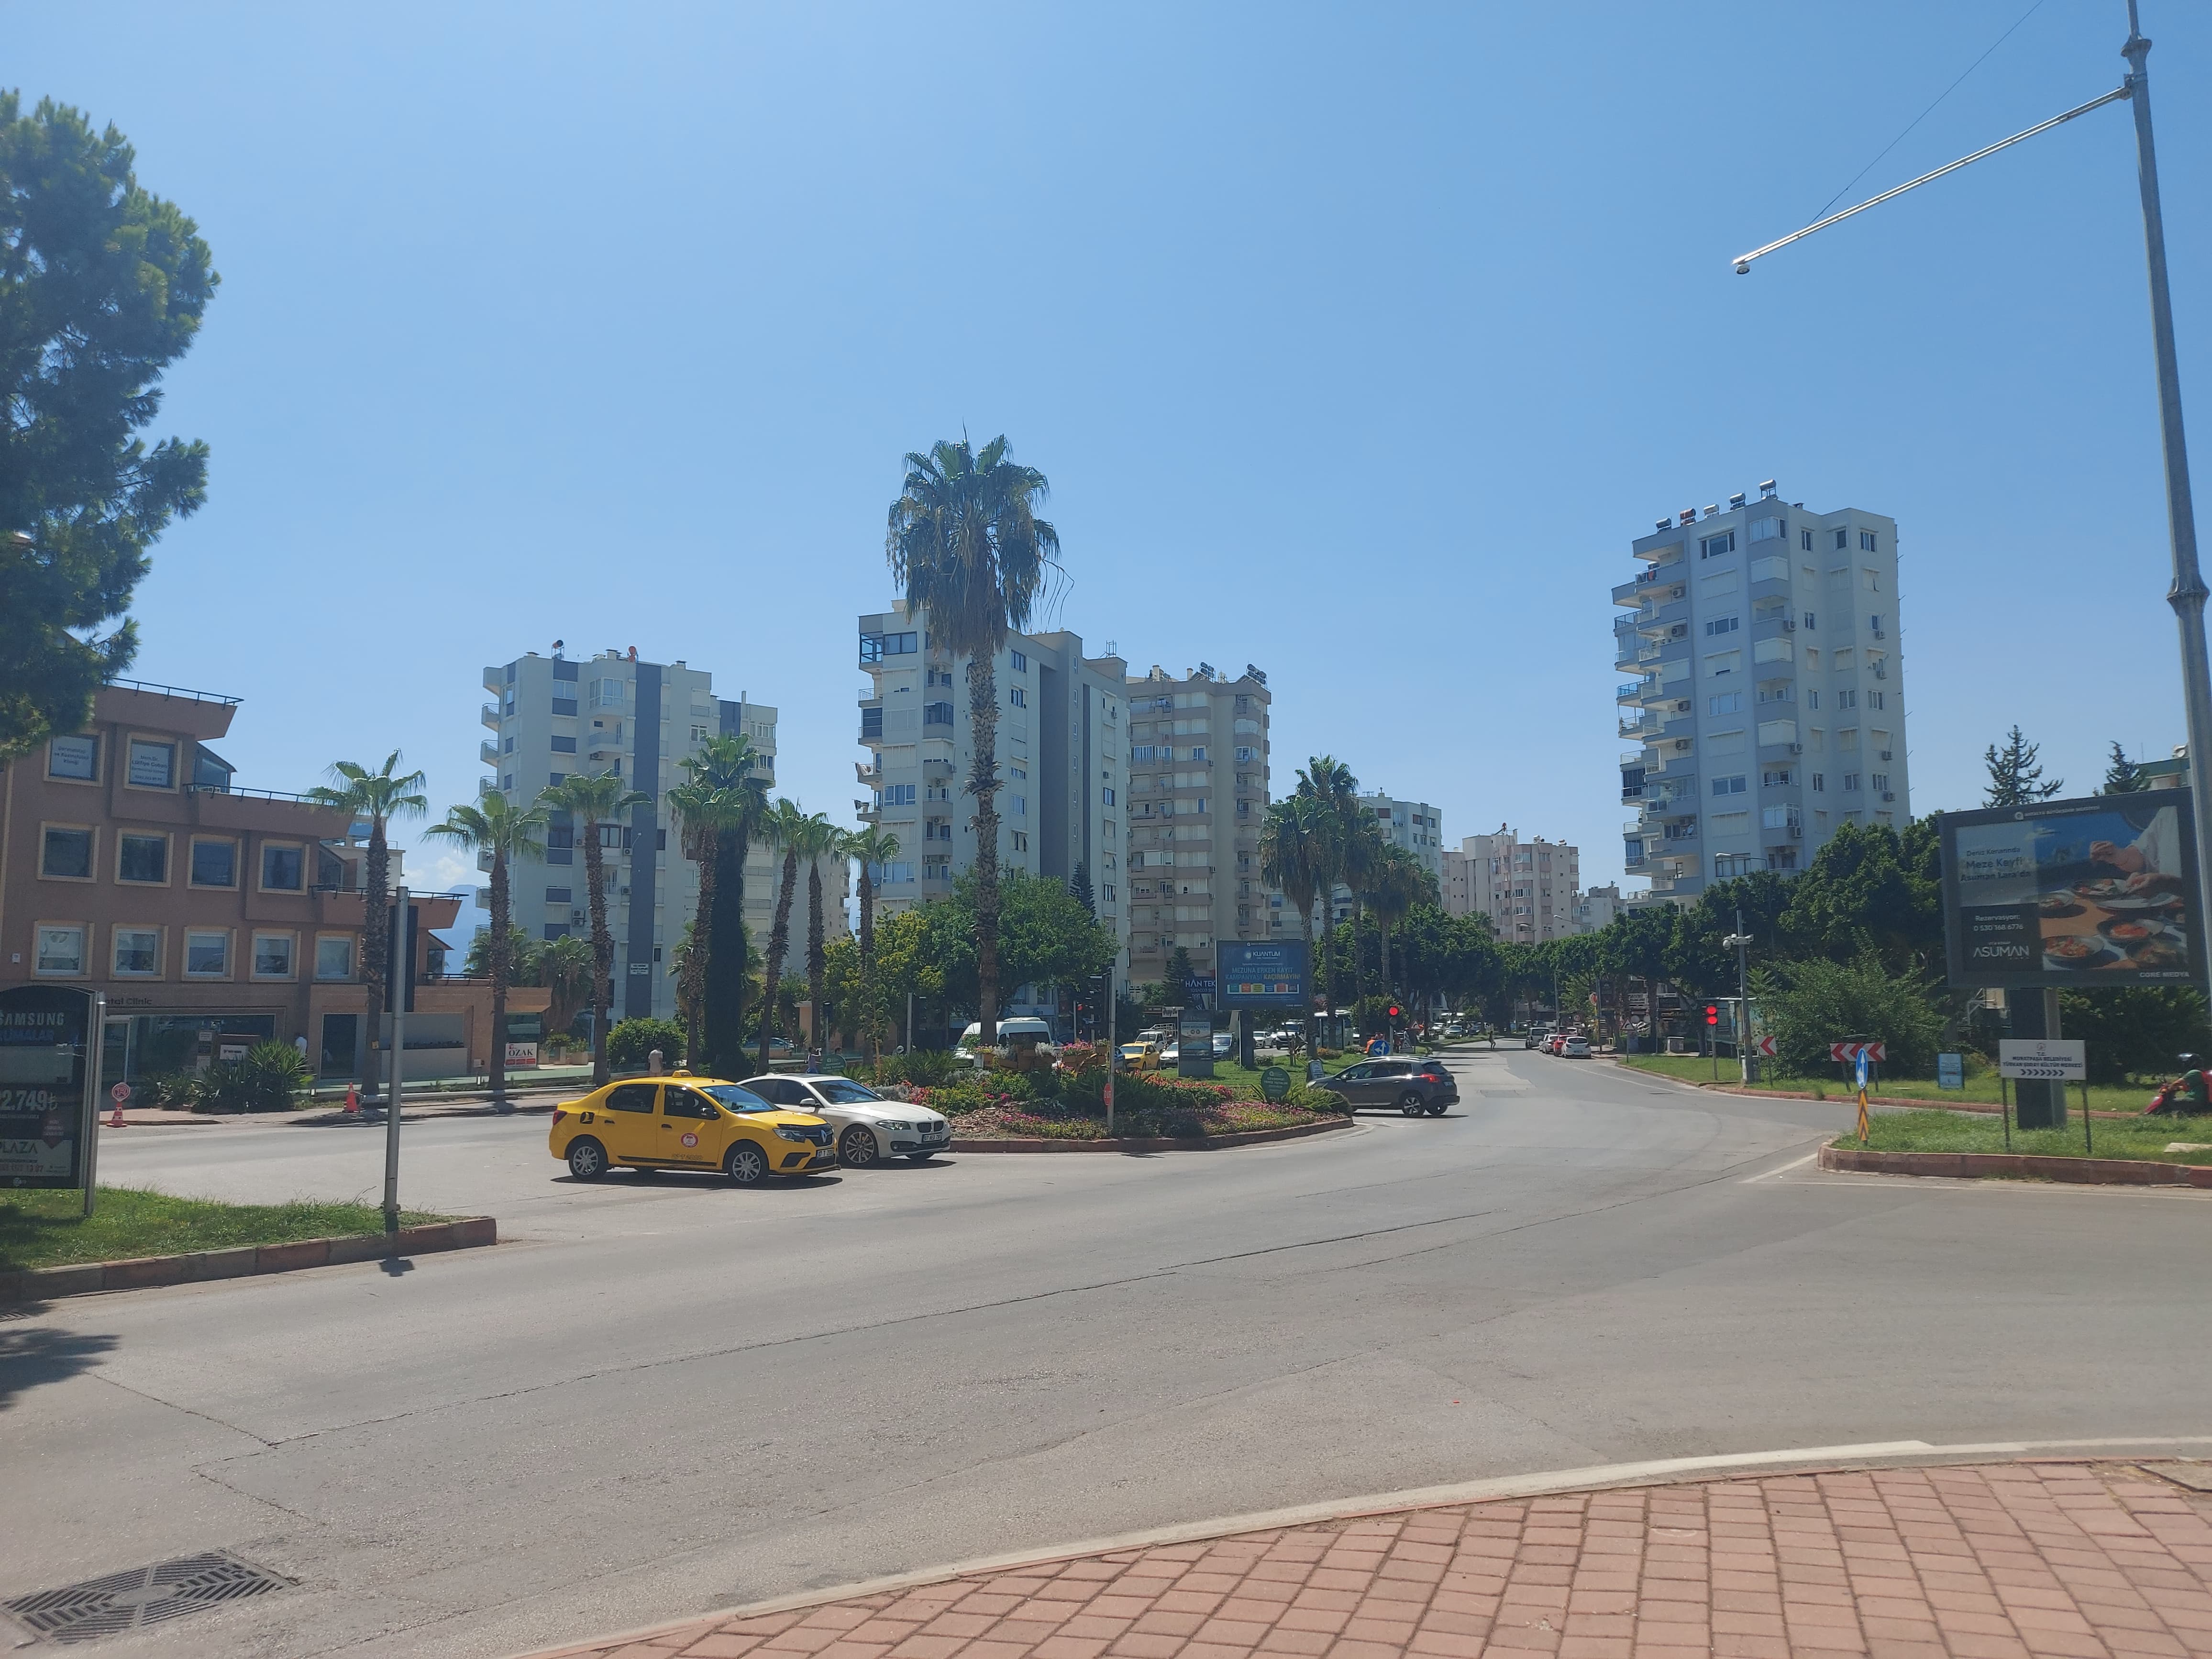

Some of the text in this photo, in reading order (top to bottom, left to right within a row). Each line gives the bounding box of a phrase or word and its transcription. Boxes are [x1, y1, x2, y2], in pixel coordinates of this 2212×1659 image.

[1967, 857, 2023, 869] Meze Keyfi
[1973, 945, 2029, 958] ASUMAN
[1185, 979, 1202, 987] HAN
